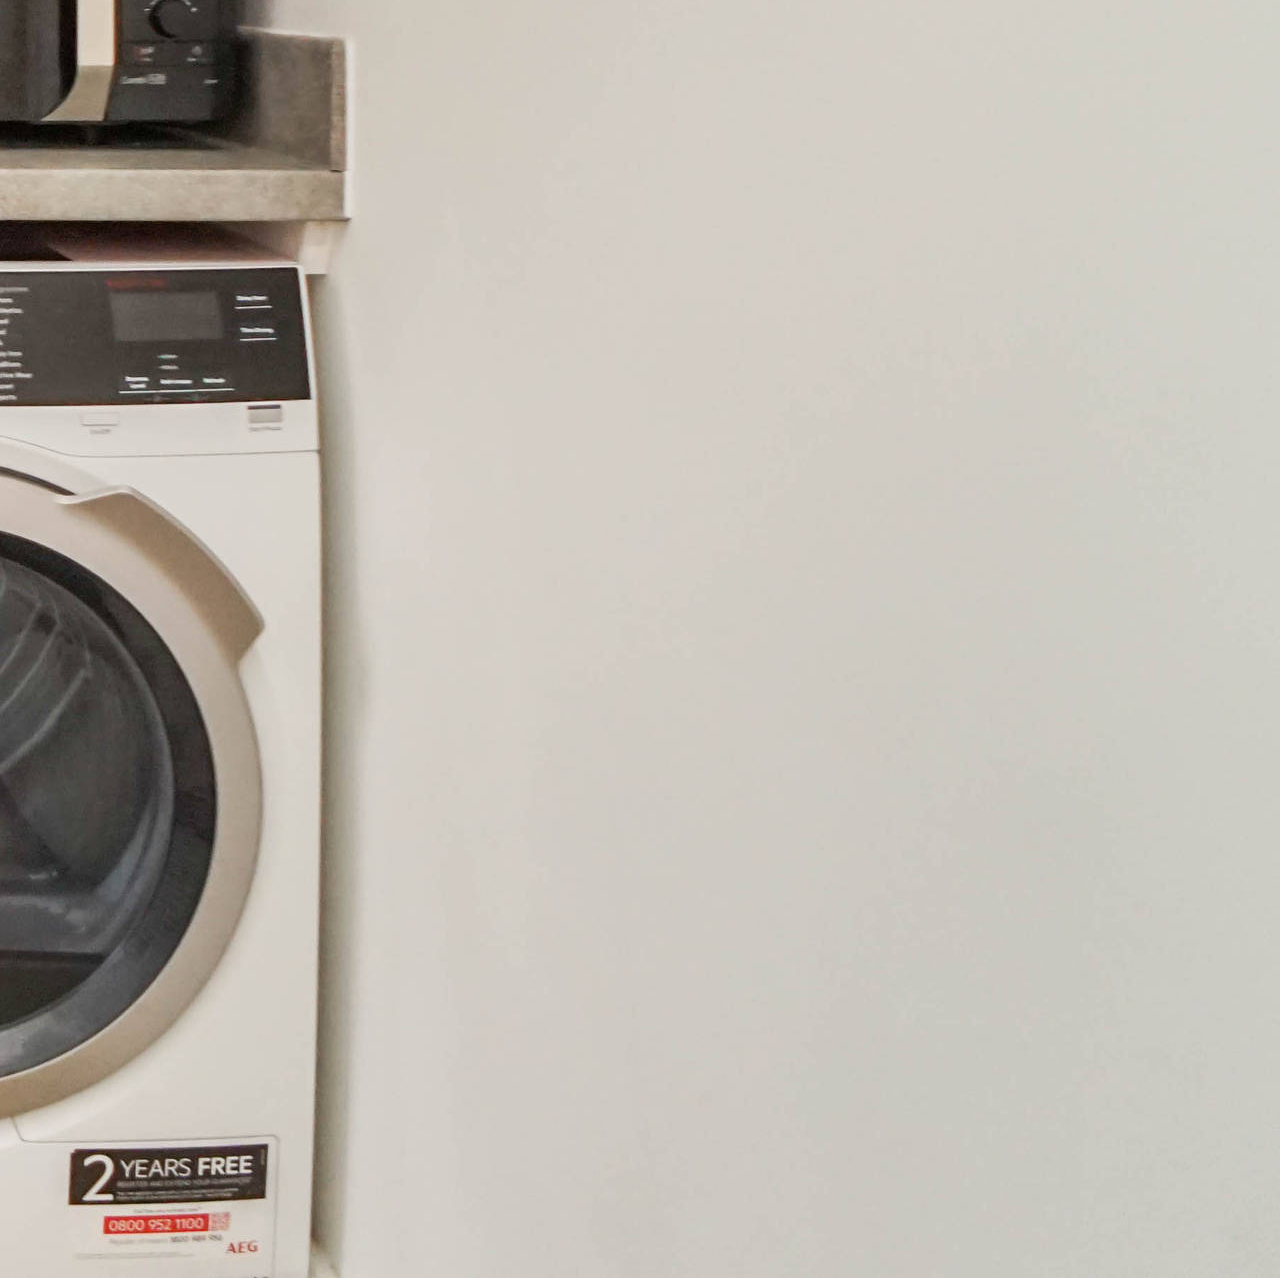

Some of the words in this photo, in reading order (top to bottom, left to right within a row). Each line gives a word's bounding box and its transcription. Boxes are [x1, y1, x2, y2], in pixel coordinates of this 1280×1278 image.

[81, 1154, 115, 1201] 2
[120, 1158, 191, 1179] YEARS
[197, 1155, 254, 1176] FREE
[108, 1219, 145, 1232] 0800
[148, 1218, 171, 1231] 952
[174, 1217, 204, 1230] 1100
[226, 1240, 259, 1254] AEG
